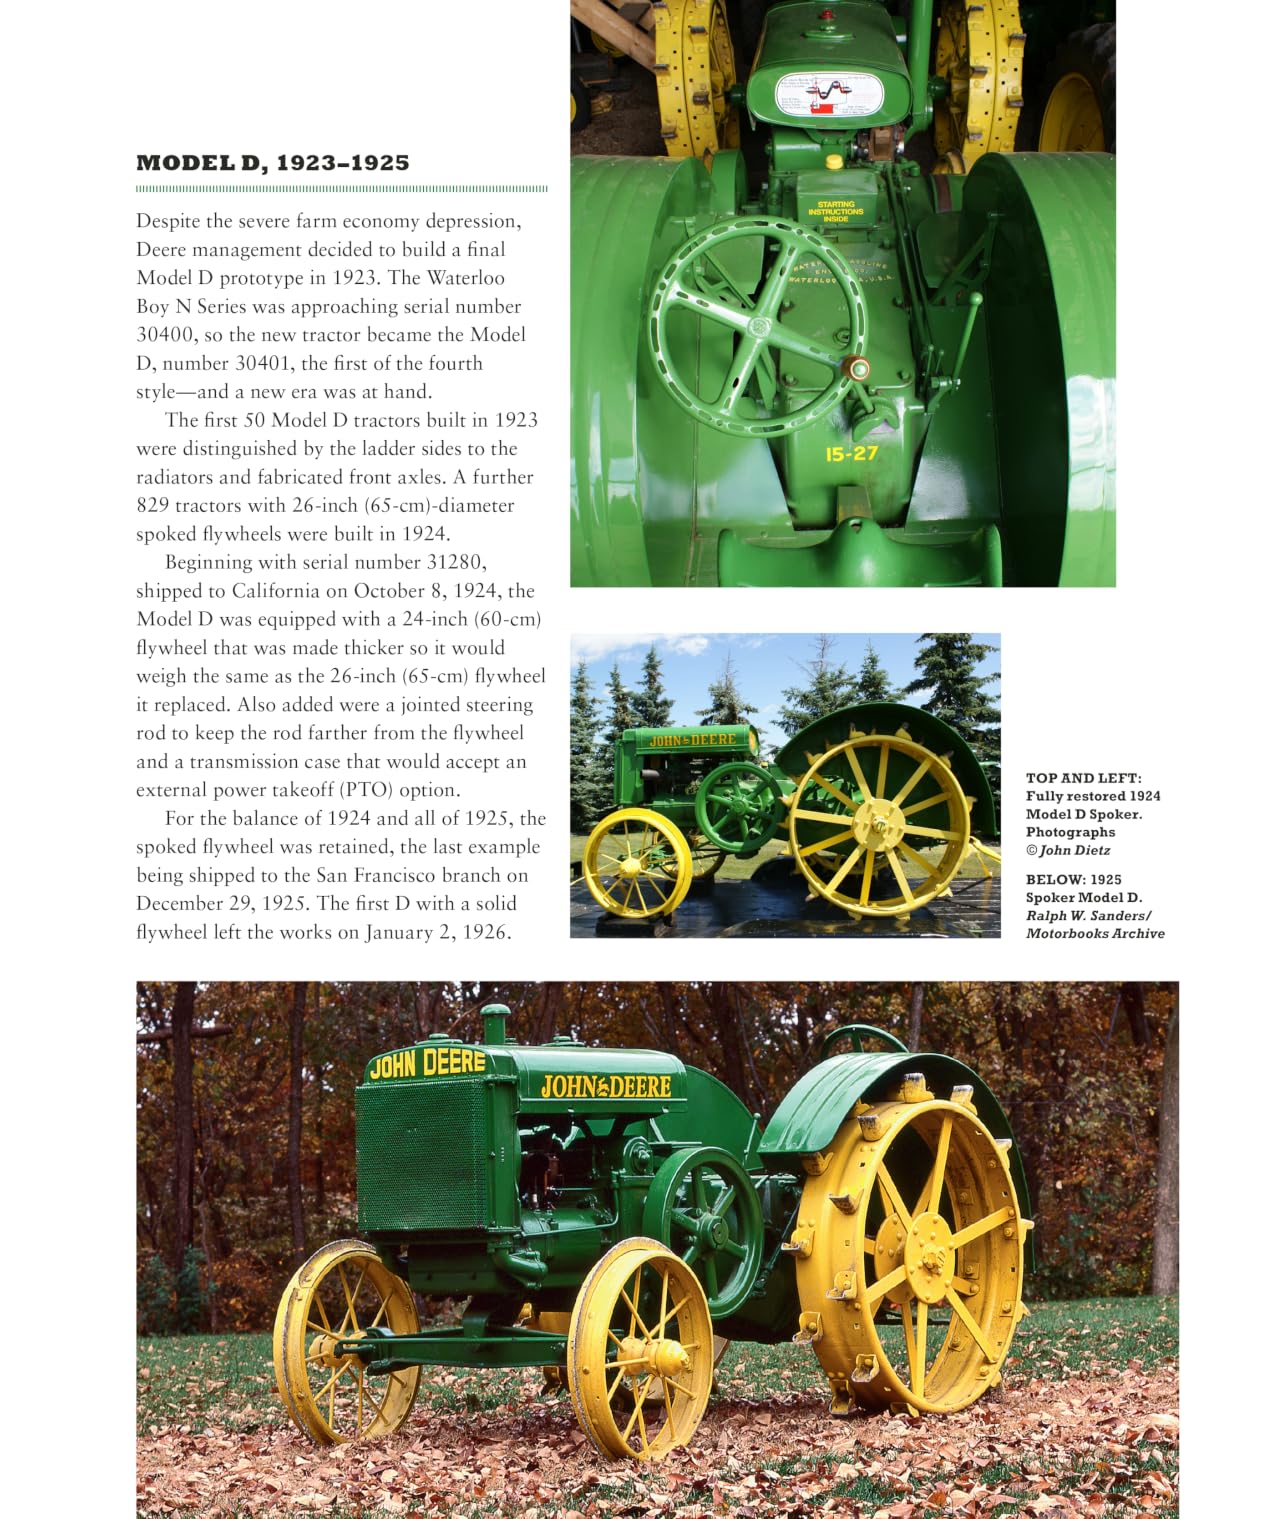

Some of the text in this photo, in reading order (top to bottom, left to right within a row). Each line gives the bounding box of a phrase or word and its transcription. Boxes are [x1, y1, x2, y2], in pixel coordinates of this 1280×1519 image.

[136, 154, 236, 171] MODEL
[241, 154, 269, 176] D,
[817, 200, 856, 208] STARTING
[808, 208, 865, 216] INSTRUCTIONS
[136, 211, 522, 233] Despite the severe farm economy depression,
[849, 258, 889, 270] ASOLINE
[826, 445, 880, 463] 15-27
[165, 552, 487, 574] Beginning with serial number 31280,
[649, 733, 737, 748] JOHN DEERE
[1025, 772, 1142, 784] TOP AND LEFT:
[136, 780, 461, 802] external power takeoff (PTO) option.
[1025, 790, 1161, 805] Fully restored 1924
[1025, 808, 1143, 823] Model D Spoker.
[1025, 826, 1116, 841] Photographs
[1073, 844, 1113, 857] Dietz
[1025, 874, 1122, 886] BELOW: 1925
[1026, 891, 1143, 906] Spoker Model D.
[1025, 910, 1153, 925] Ralph W. Sanders/
[1025, 927, 1166, 939] Motorbooks Archive
[370, 1047, 486, 1080] JOHN DEERE
[541, 1074, 672, 1098] JOHN DEERE
